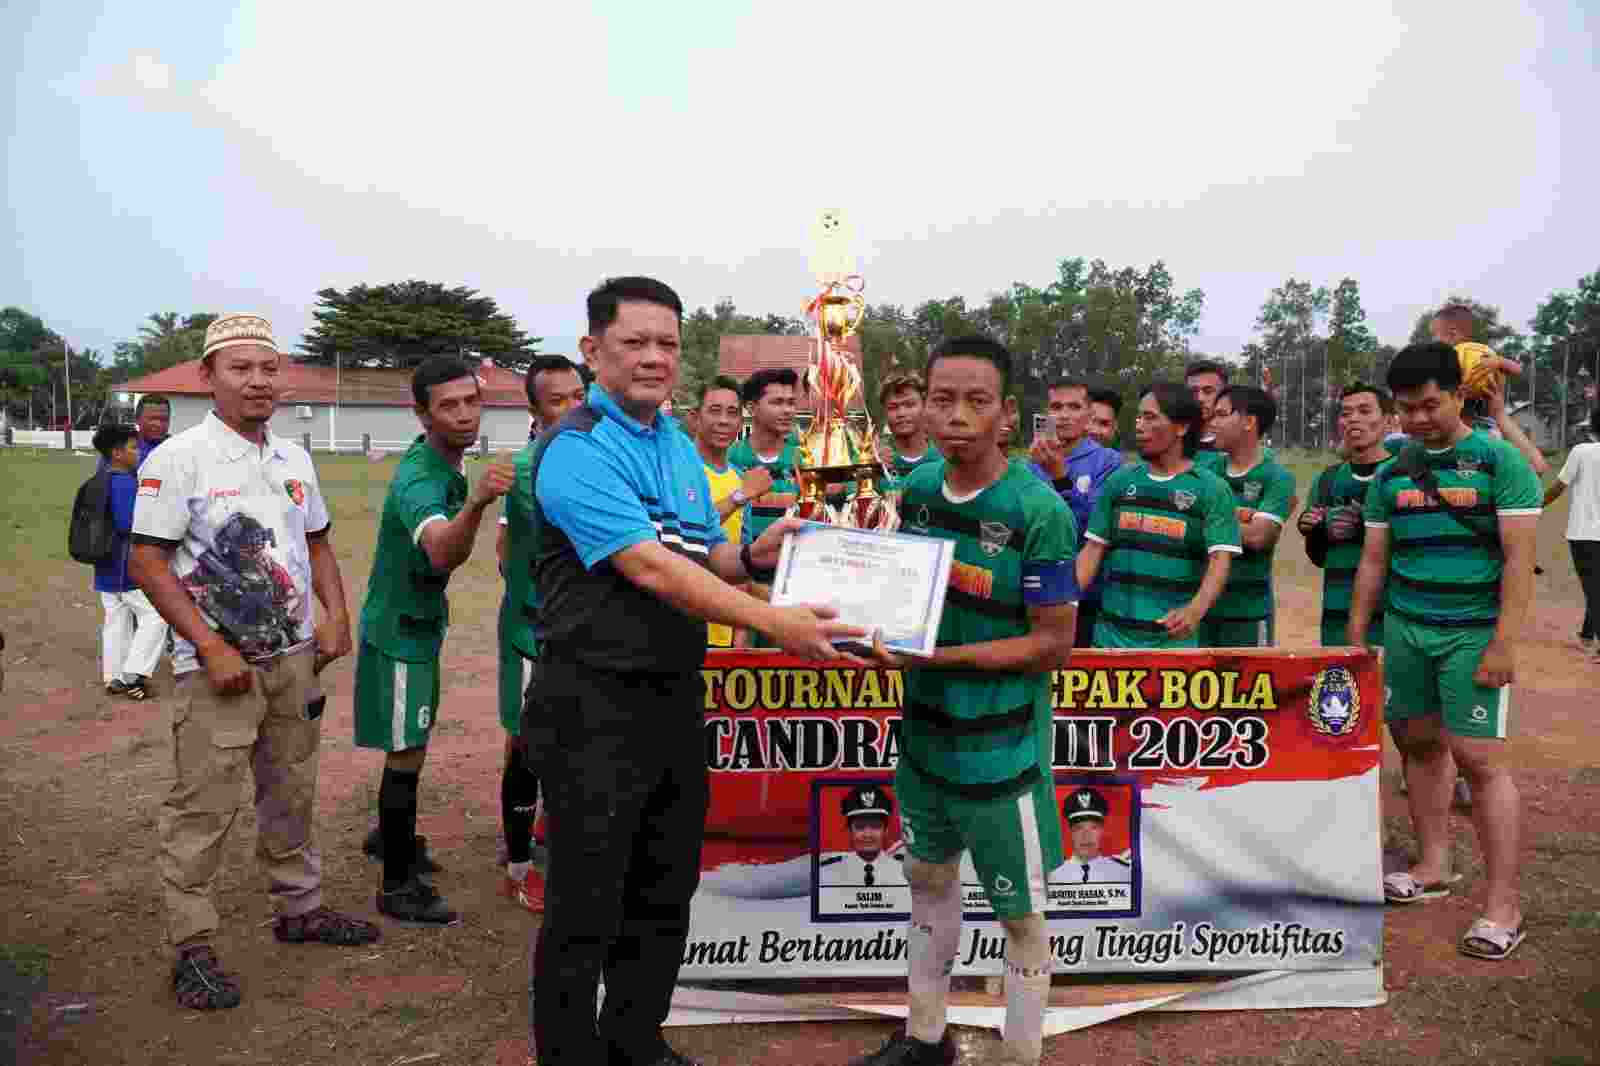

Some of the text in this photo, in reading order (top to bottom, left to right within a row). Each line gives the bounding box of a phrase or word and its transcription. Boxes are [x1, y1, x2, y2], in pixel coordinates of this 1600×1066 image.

[1051, 669, 1277, 710] PAK BOLA
[703, 716, 903, 771] CANDRA
[1127, 716, 1269, 770] 2023
[1095, 925, 1184, 964] Tinggi
[1191, 923, 1345, 961] Sportifitas
